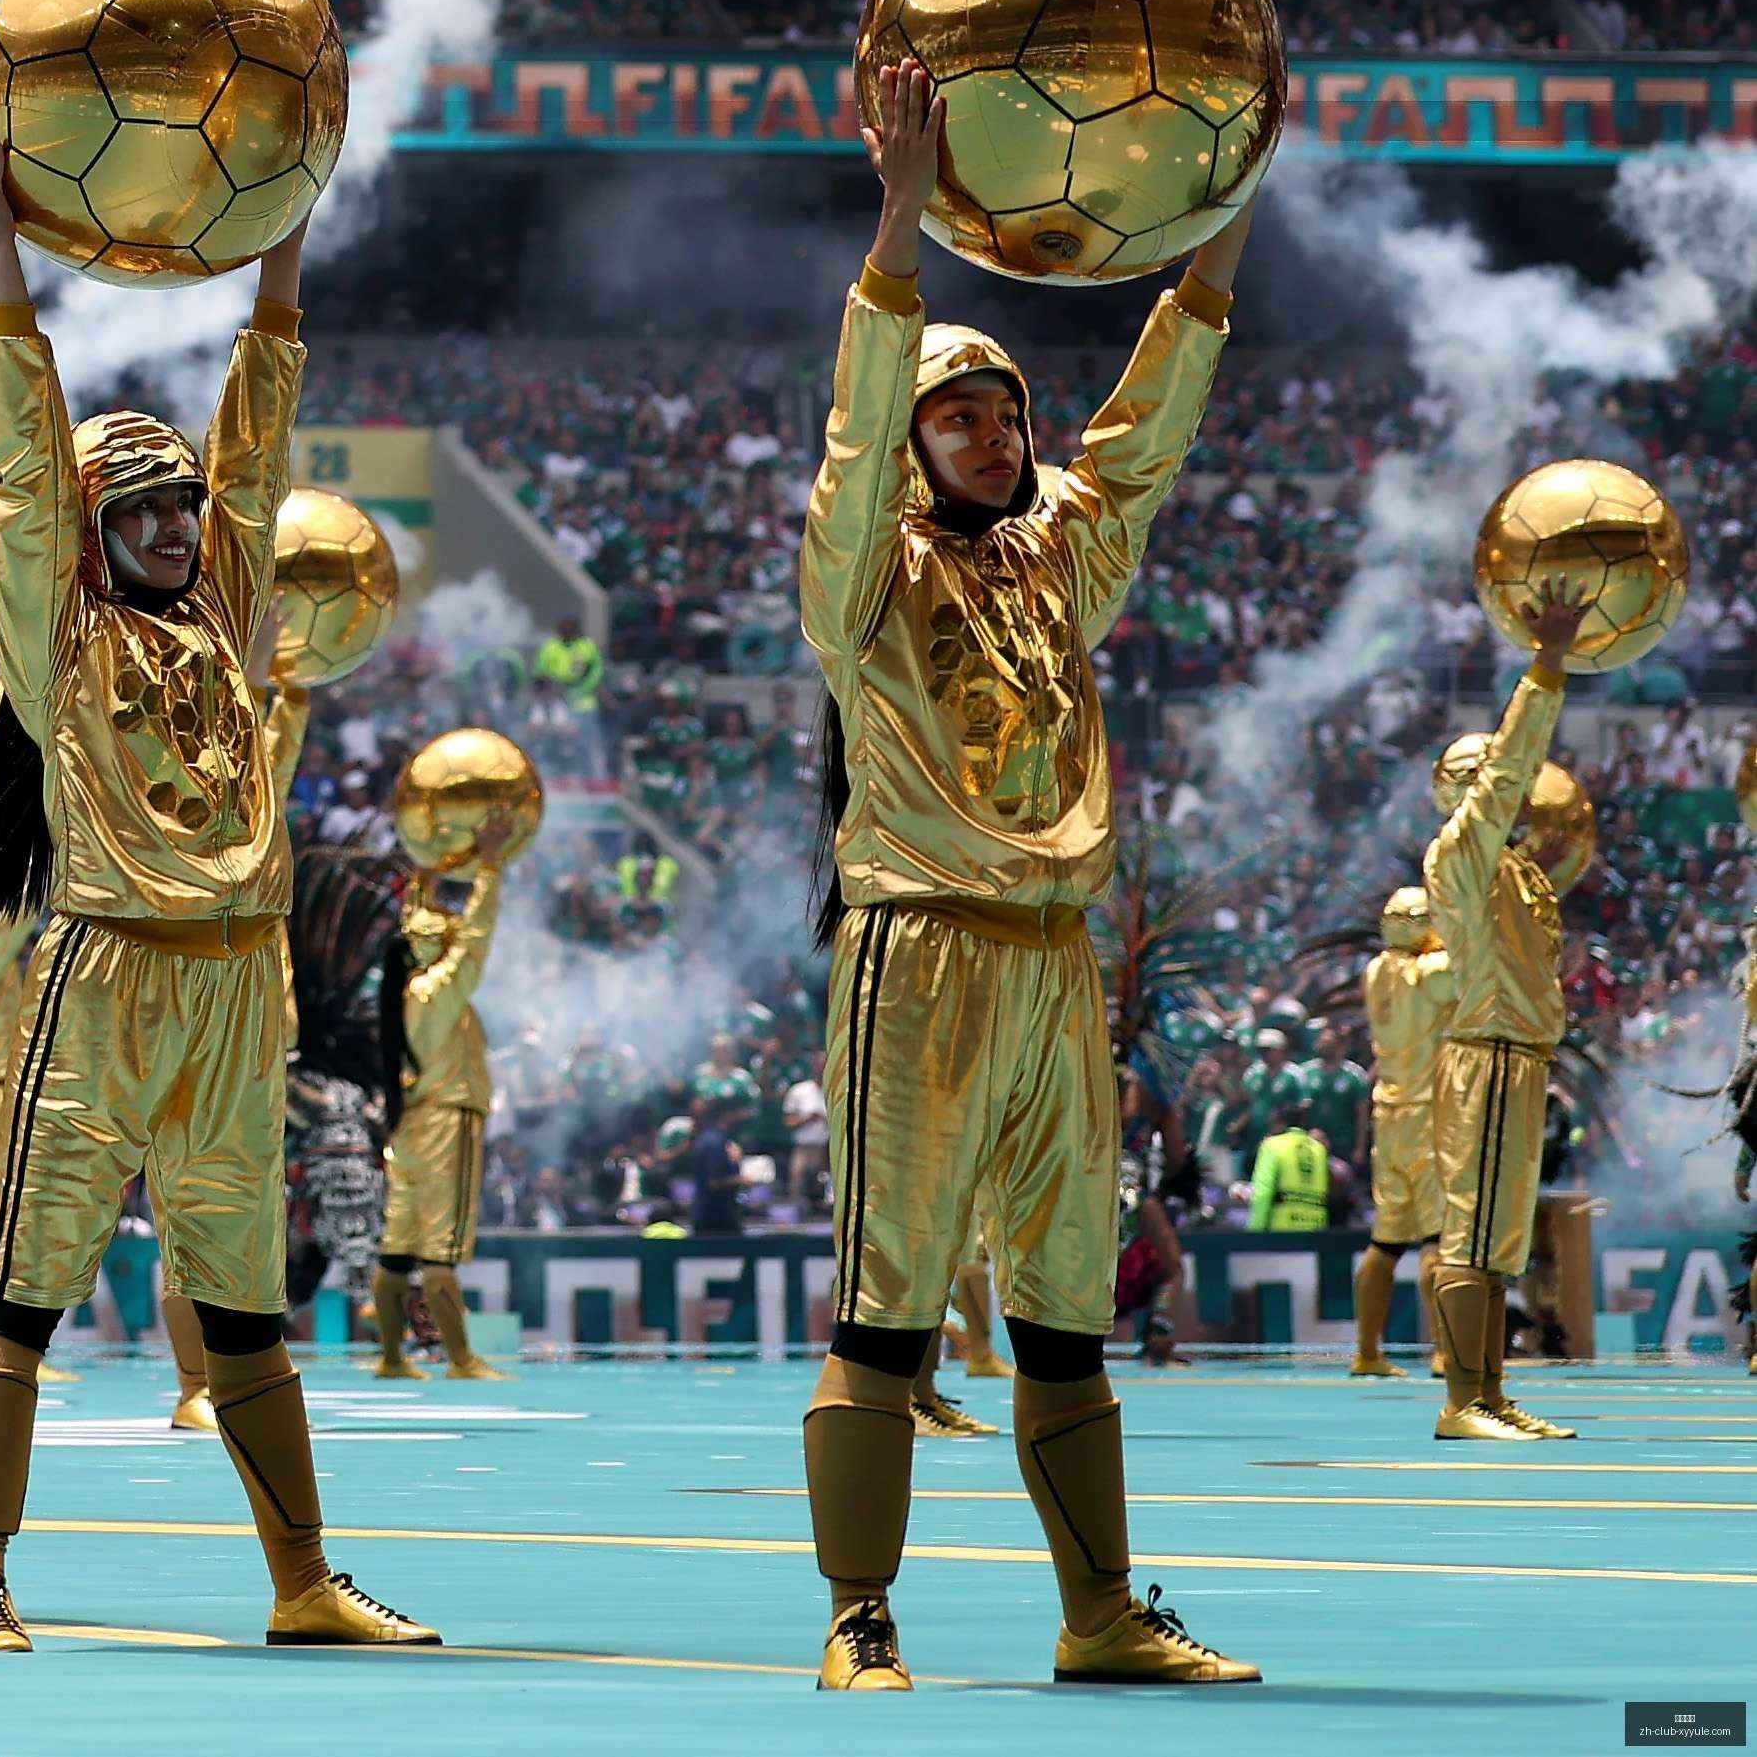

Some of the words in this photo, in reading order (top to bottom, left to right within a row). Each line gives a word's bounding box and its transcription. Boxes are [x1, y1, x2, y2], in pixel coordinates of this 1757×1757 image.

[613, 63, 823, 139] FIFA
[1287, 73, 1429, 146] IFA
[1602, 1247, 1751, 1350] FA
